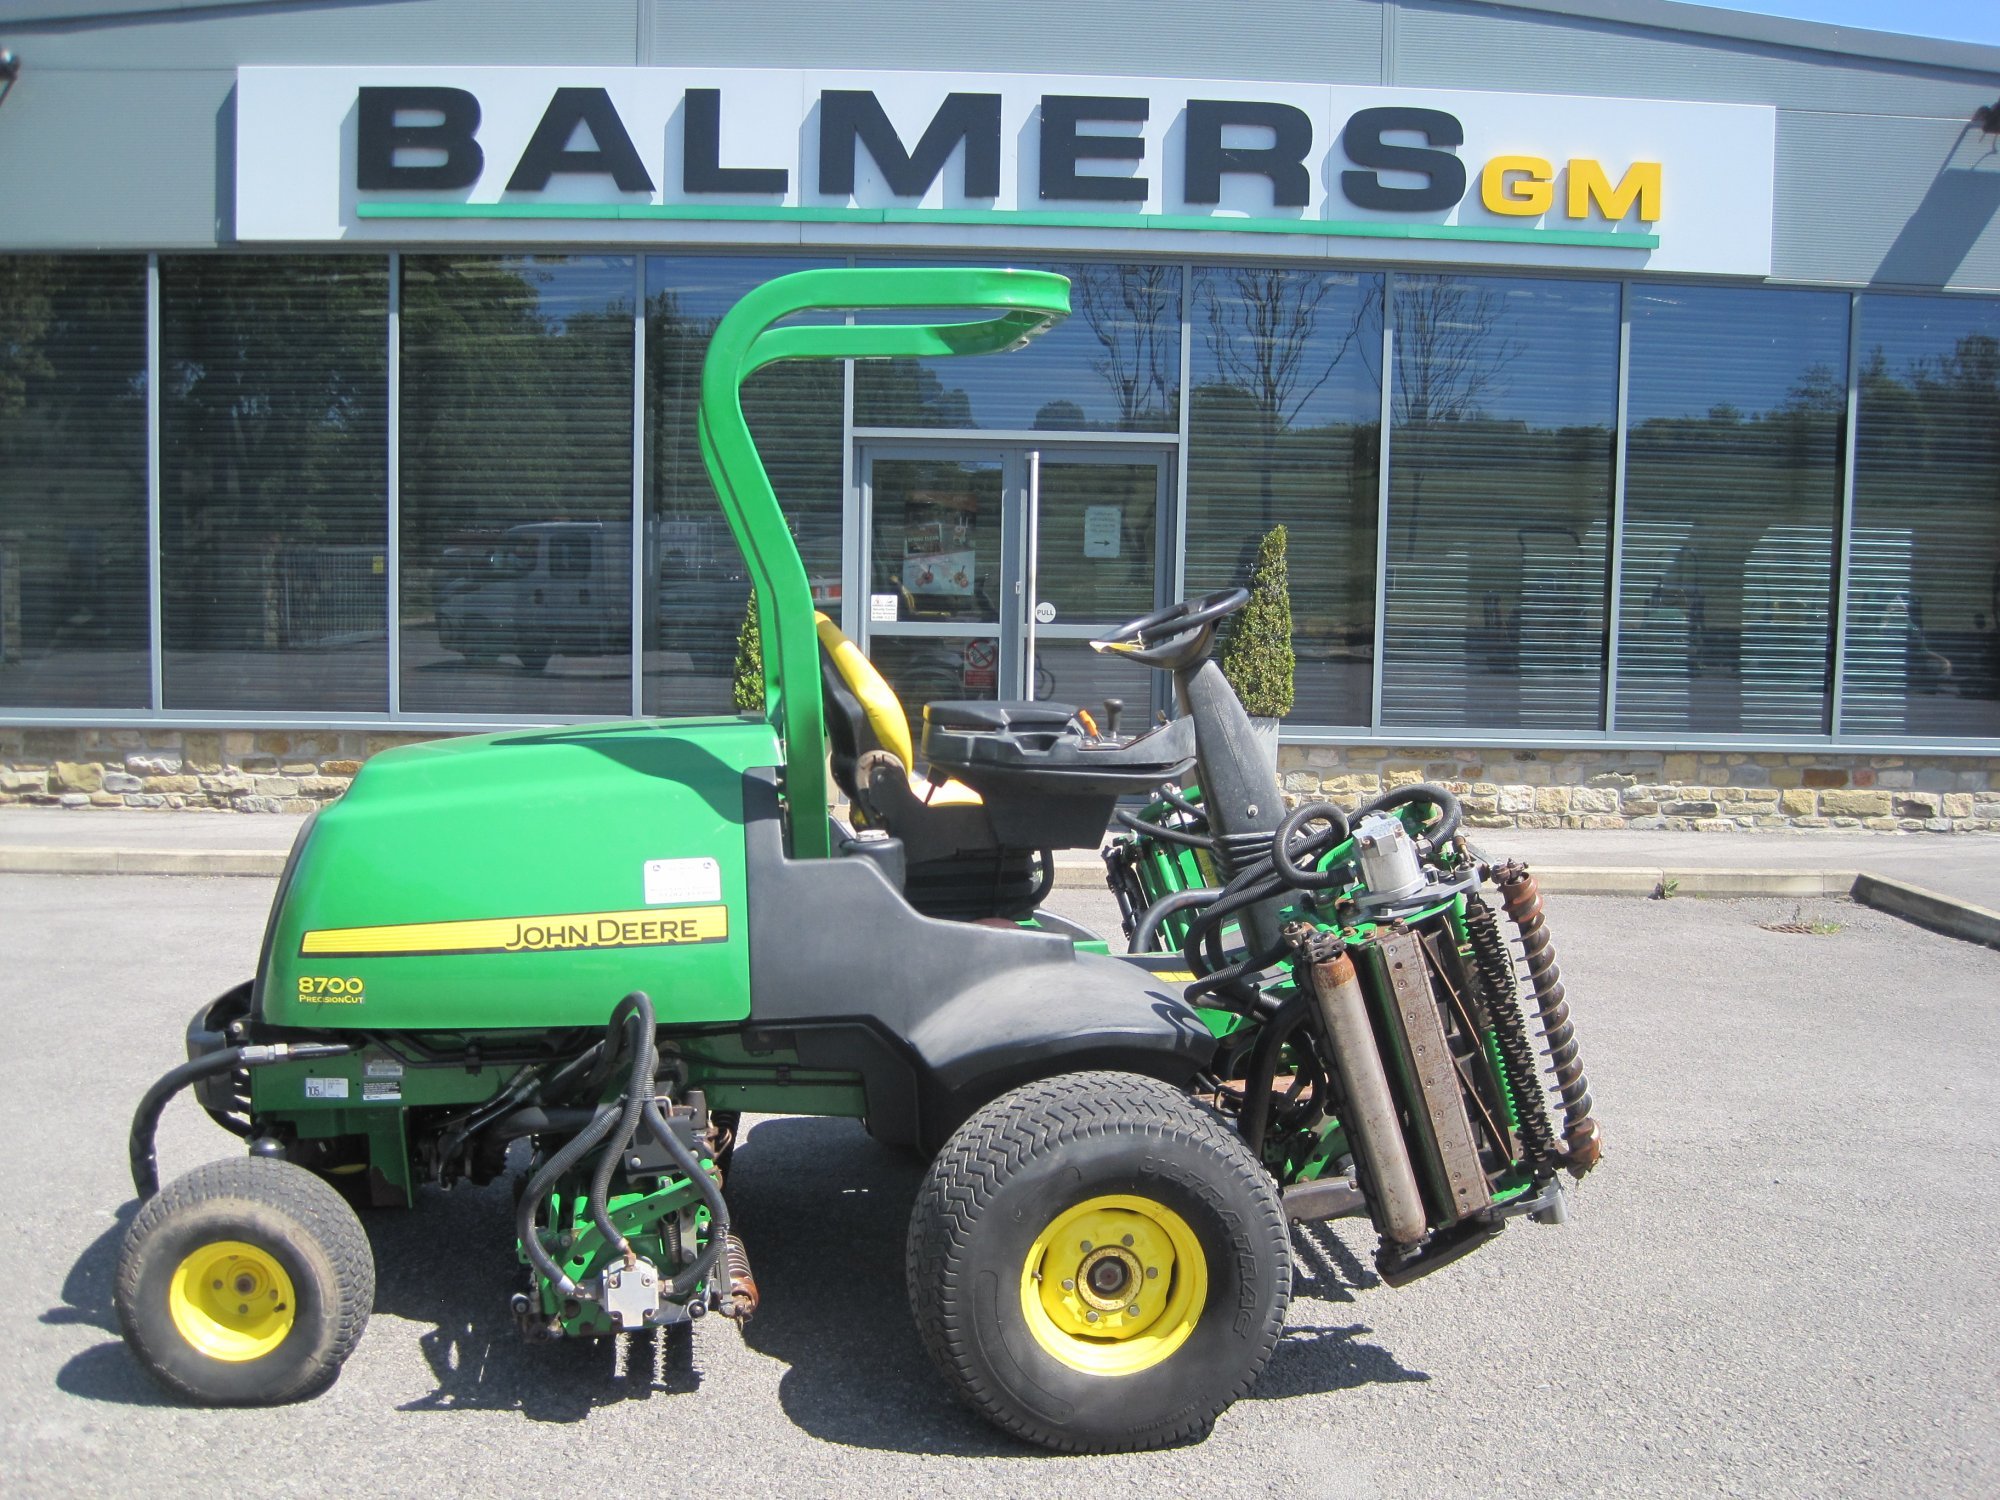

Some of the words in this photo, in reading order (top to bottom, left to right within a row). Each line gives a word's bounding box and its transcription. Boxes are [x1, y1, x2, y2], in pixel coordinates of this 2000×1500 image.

[357, 87, 1466, 211] BALMERS
[1481, 155, 1662, 221] GM
[506, 924, 588, 947] JOHN
[597, 920, 698, 942] DEERE
[298, 976, 364, 994] 8700
[307, 1086, 320, 1097] 105
